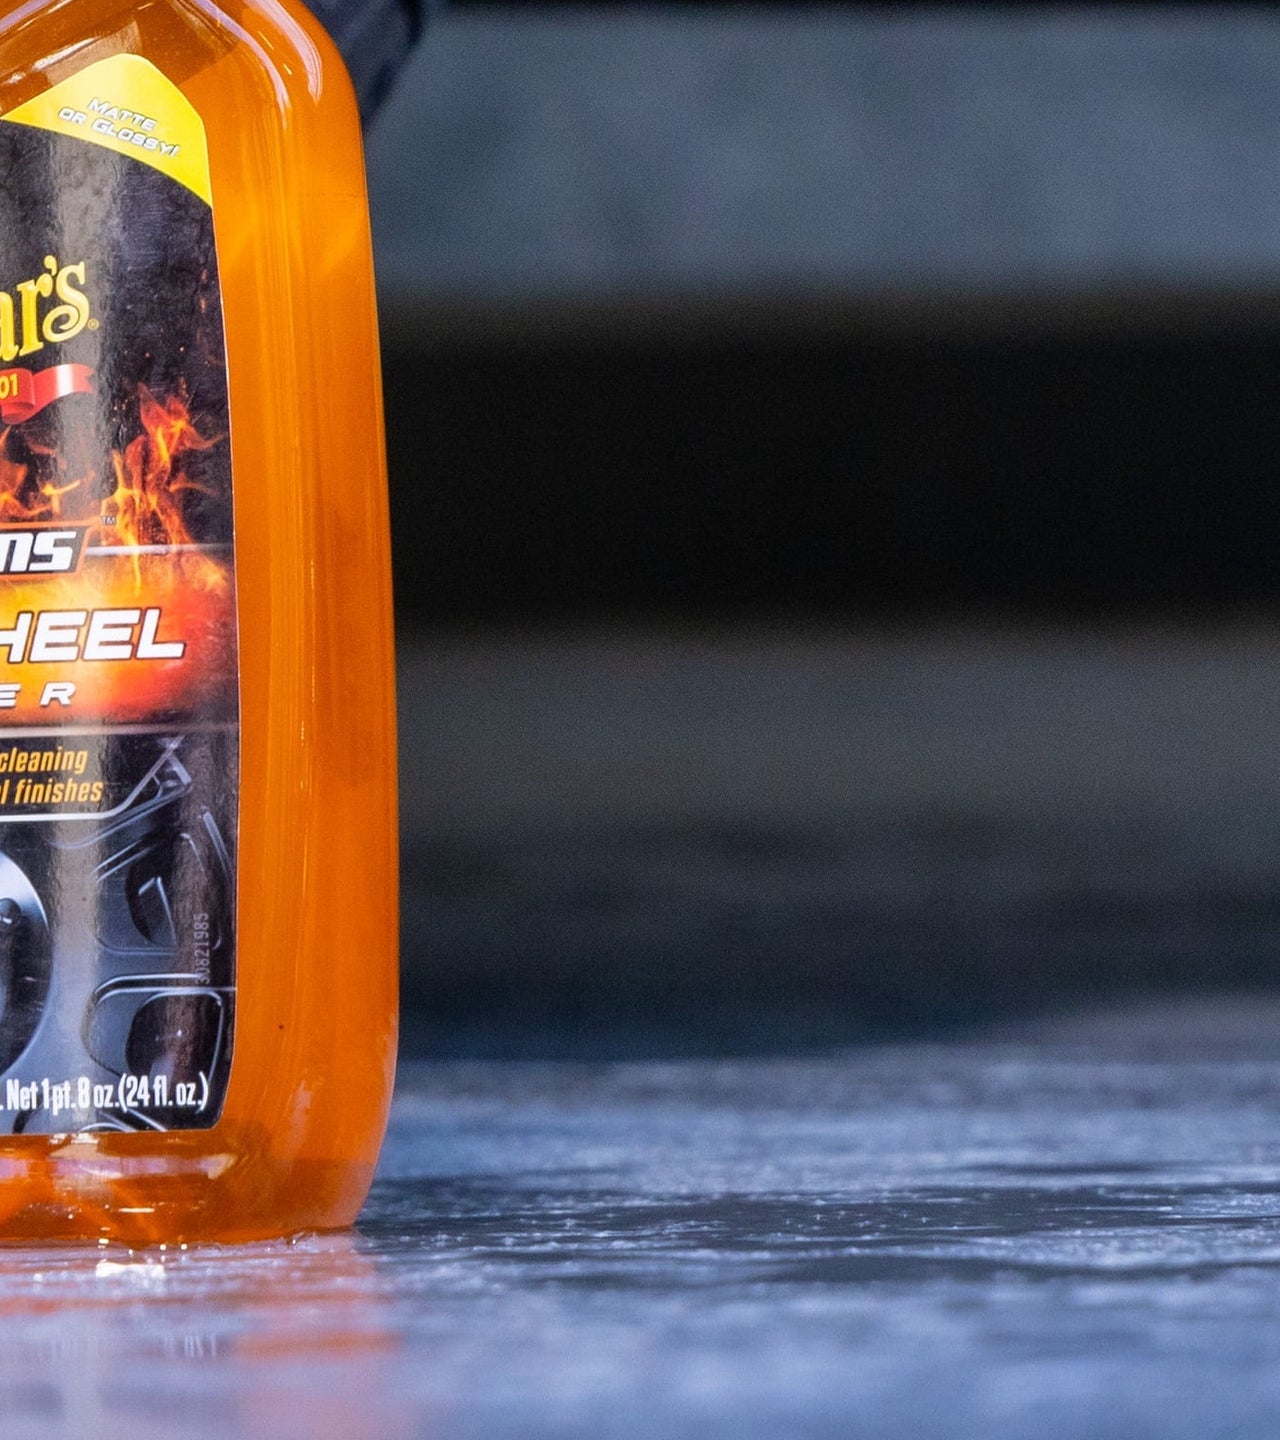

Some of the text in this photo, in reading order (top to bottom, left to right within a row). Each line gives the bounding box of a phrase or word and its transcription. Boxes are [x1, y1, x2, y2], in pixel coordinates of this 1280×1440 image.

[58, 107, 180, 158] OR GLOSSY!
[87, 97, 159, 132] MATTE
[13, 777, 104, 804] finishes
[6, 1078, 39, 1111] Net
[152, 1074, 173, 1107] fl.
[175, 1071, 209, 1112] oz.)
